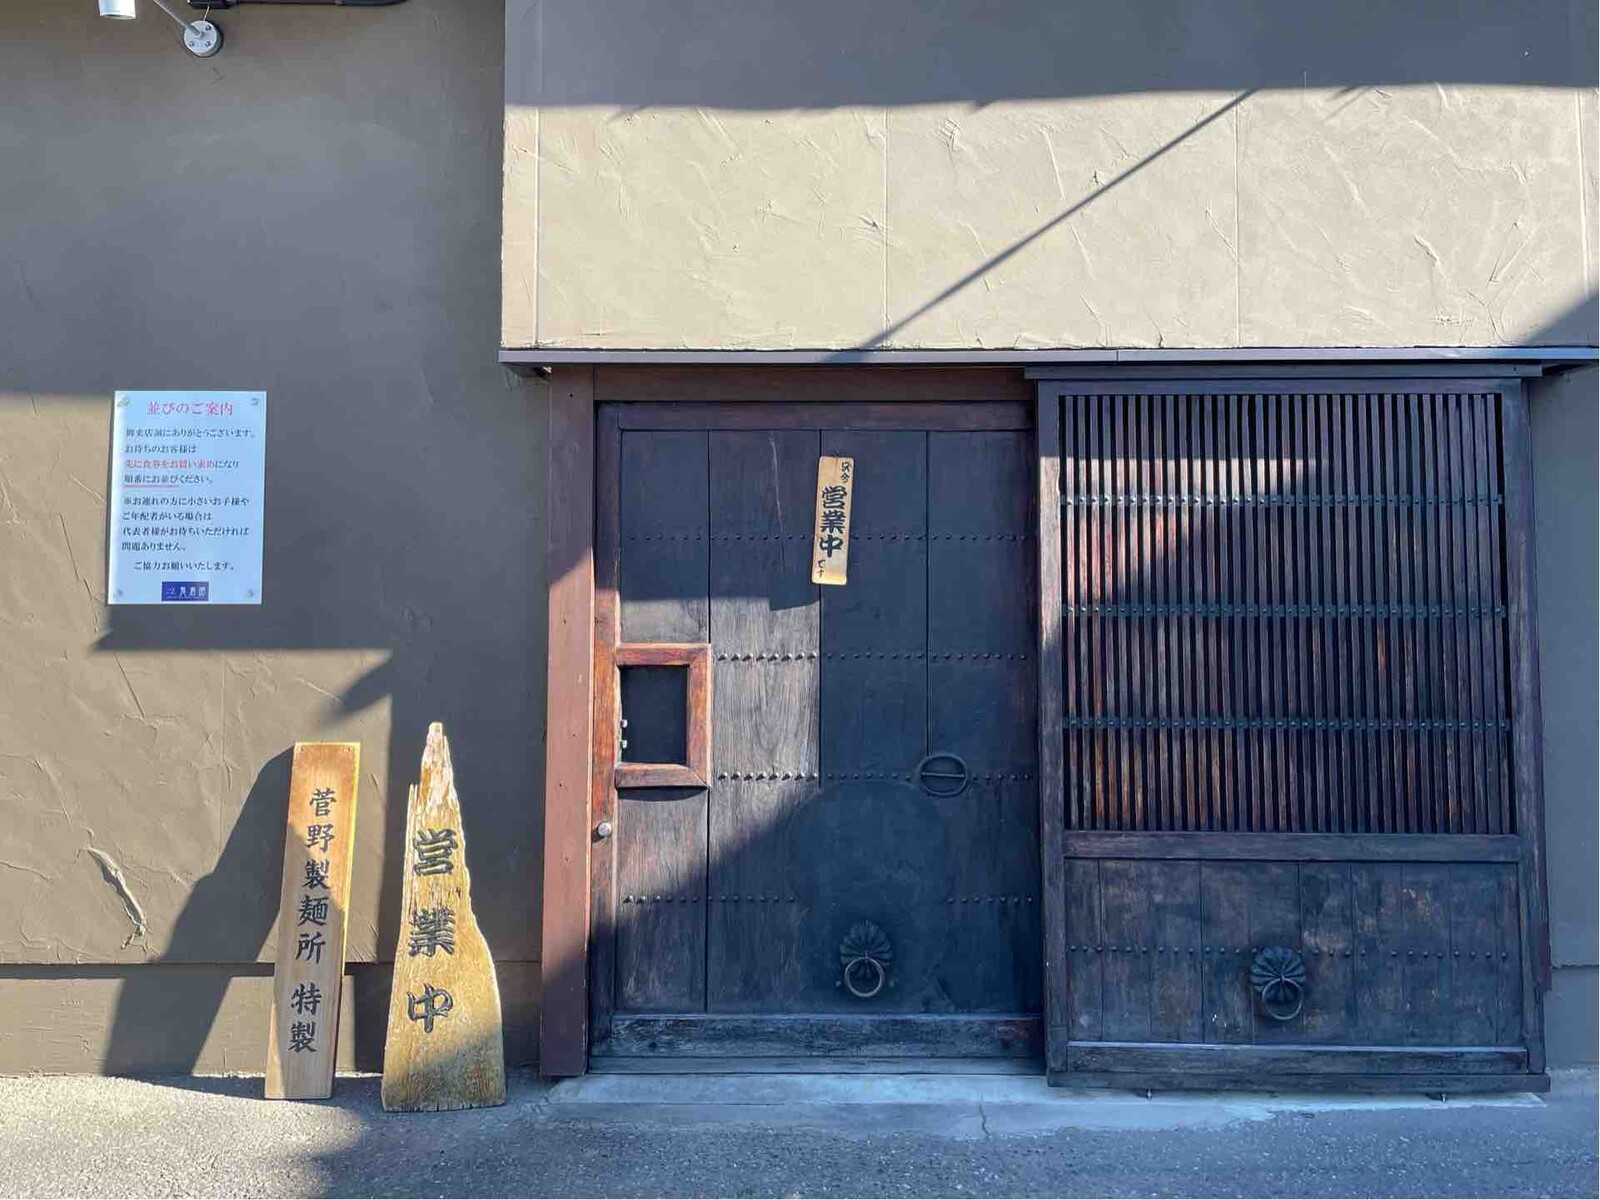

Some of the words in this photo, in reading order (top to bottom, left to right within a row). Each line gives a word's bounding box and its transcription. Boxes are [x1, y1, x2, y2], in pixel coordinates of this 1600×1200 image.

[147, 401, 233, 416] 並びのご案内
[125, 445, 196, 453] お待ちのお客様は
[124, 474, 213, 483] 順番にお並びください。
[124, 496, 250, 507] ※お連れの方に小さいお子様や
[122, 512, 213, 521] ご年配者がいる場合は
[820, 486, 847, 557] 営業中
[122, 526, 249, 536] 代表者様がお待ちいただければ
[121, 542, 187, 551] 問題ありません。
[134, 561, 235, 571] ご協力お願いいたします。
[817, 560, 825, 578] です
[405, 828, 458, 1034] 営業中
